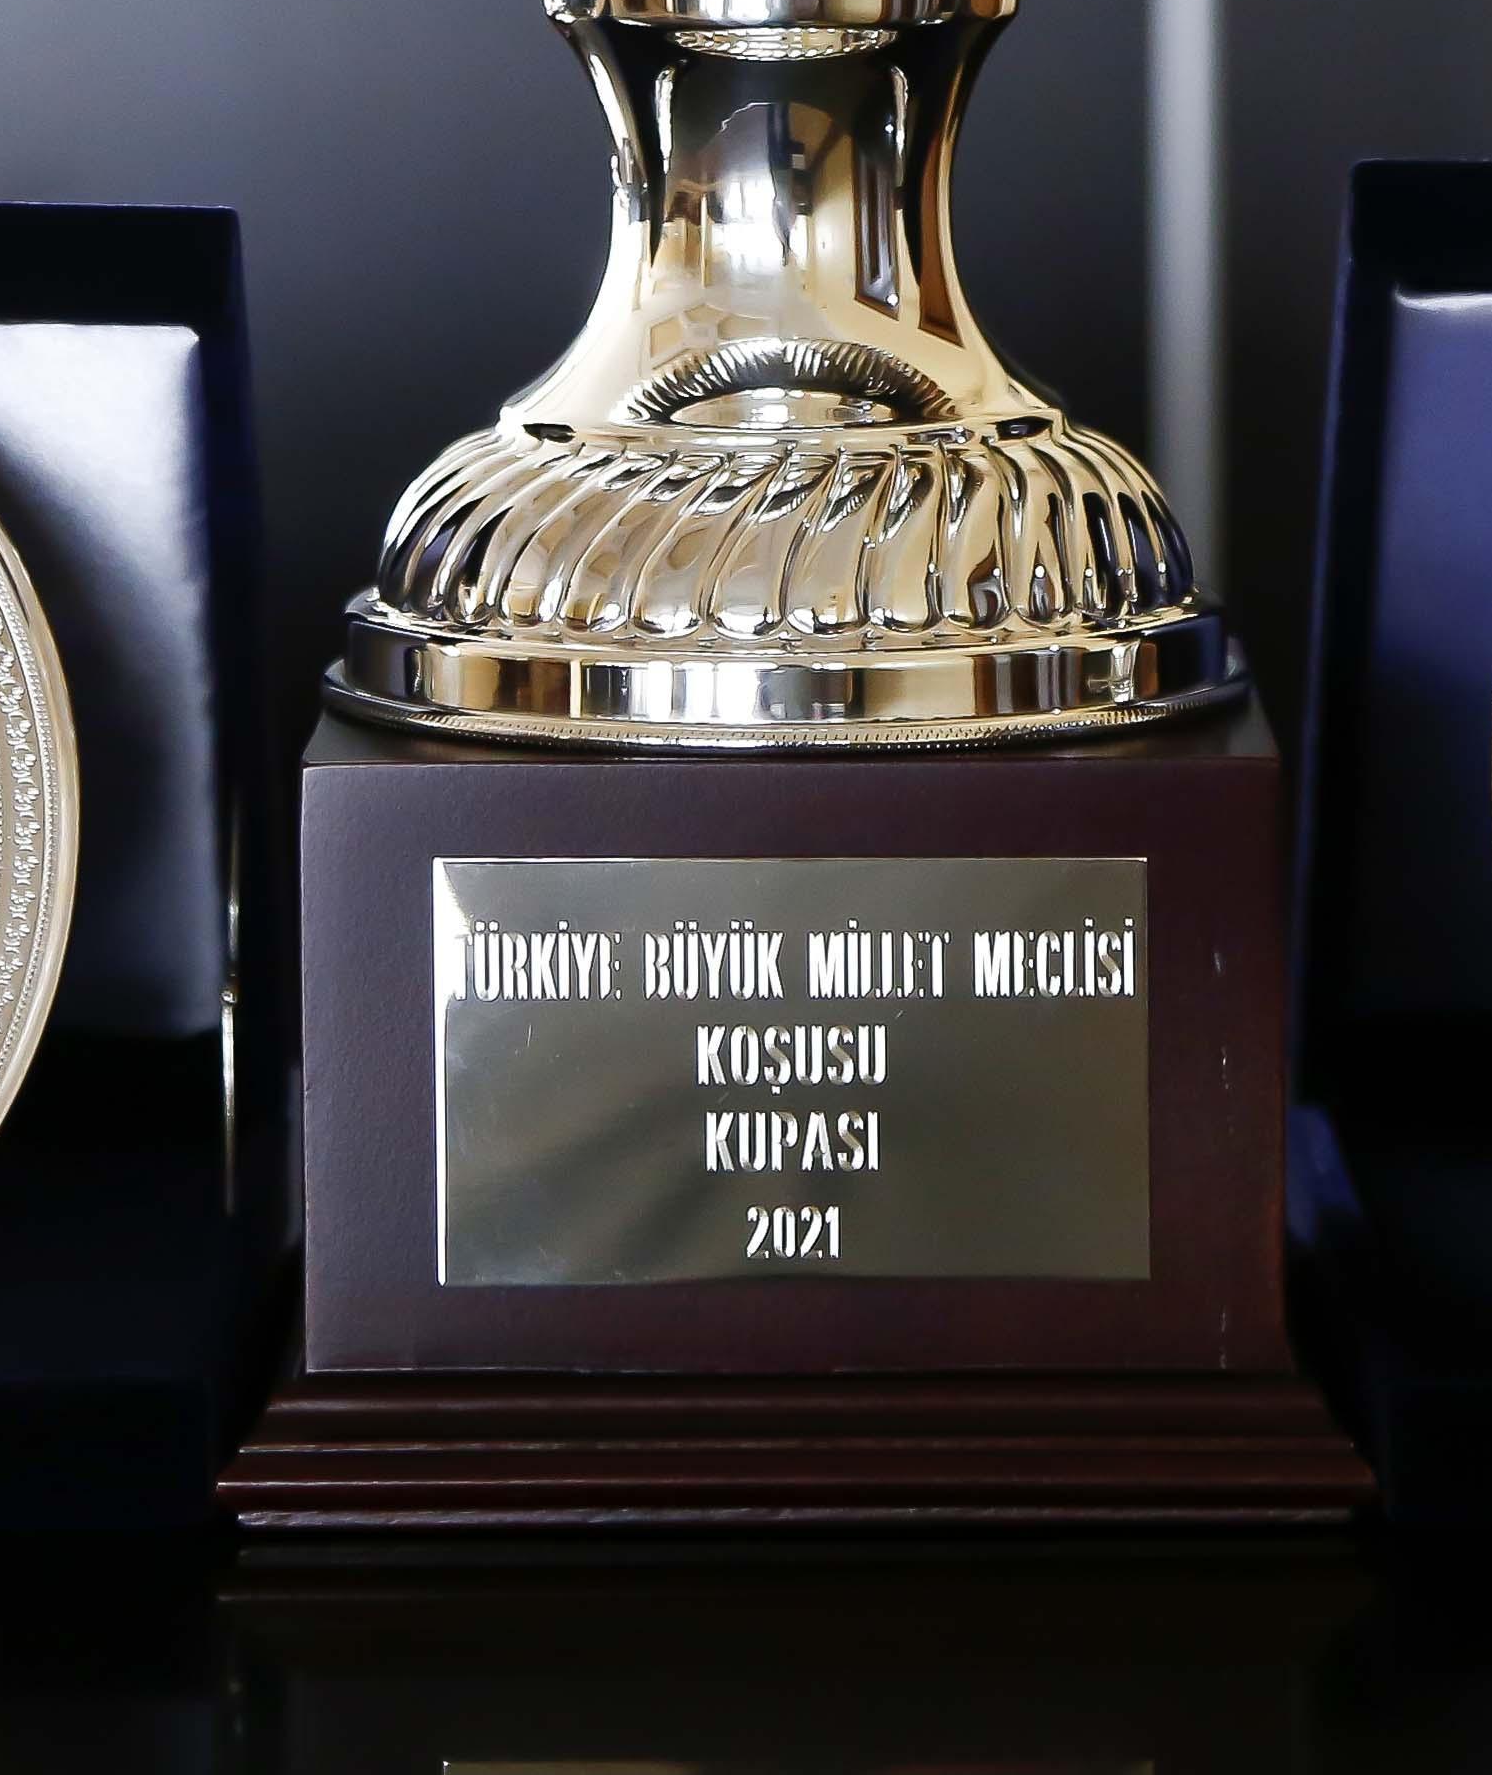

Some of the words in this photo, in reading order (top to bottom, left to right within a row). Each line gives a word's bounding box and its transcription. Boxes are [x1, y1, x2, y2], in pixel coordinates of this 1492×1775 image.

[453, 920, 622, 1002] TÜRKİYE
[642, 920, 786, 1001] BÜYÜK
[806, 919, 952, 1000] MİLLET
[972, 917, 1138, 999] MECLİSİ
[696, 1024, 889, 1096] KOŞUSU
[705, 1111, 880, 1173] KUPASI
[745, 1205, 842, 1260] 2021
